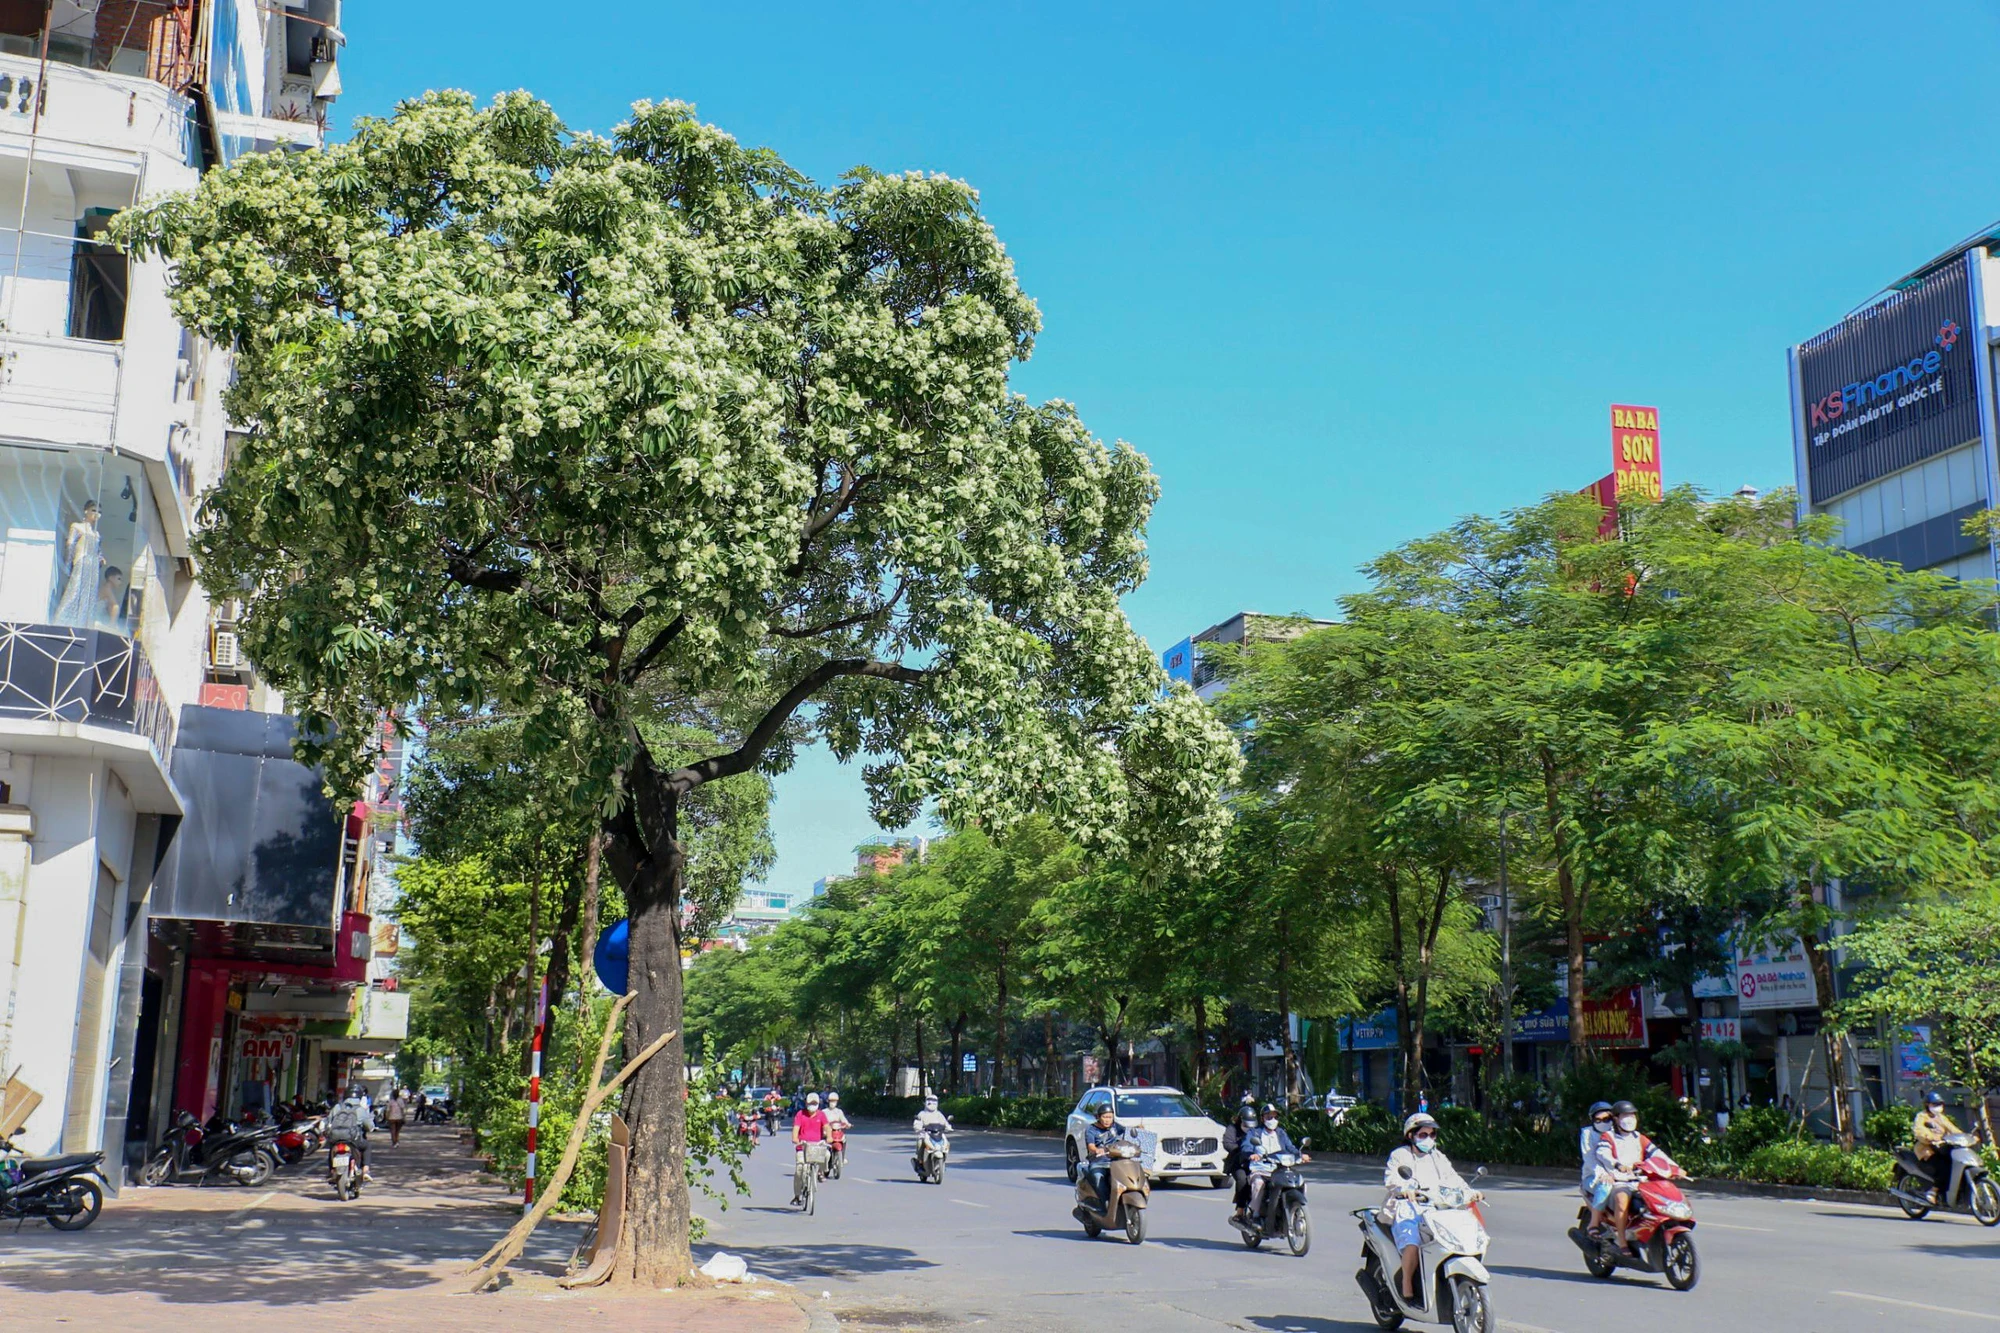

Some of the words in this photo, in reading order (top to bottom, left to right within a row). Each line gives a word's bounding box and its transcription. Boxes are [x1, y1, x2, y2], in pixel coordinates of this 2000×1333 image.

[1811, 351, 1941, 428] KSFinance
[1813, 432, 1830, 446] TẬP
[1832, 418, 1859, 439] ĐOÀN
[1880, 400, 1894, 416] TƯ
[1897, 385, 1928, 408] QUỐC
[1929, 375, 1943, 395] TẾ
[1622, 433, 1653, 464] SƠN
[1616, 462, 1661, 499] ĐÔNG
[1715, 1023, 1735, 1037] 412
